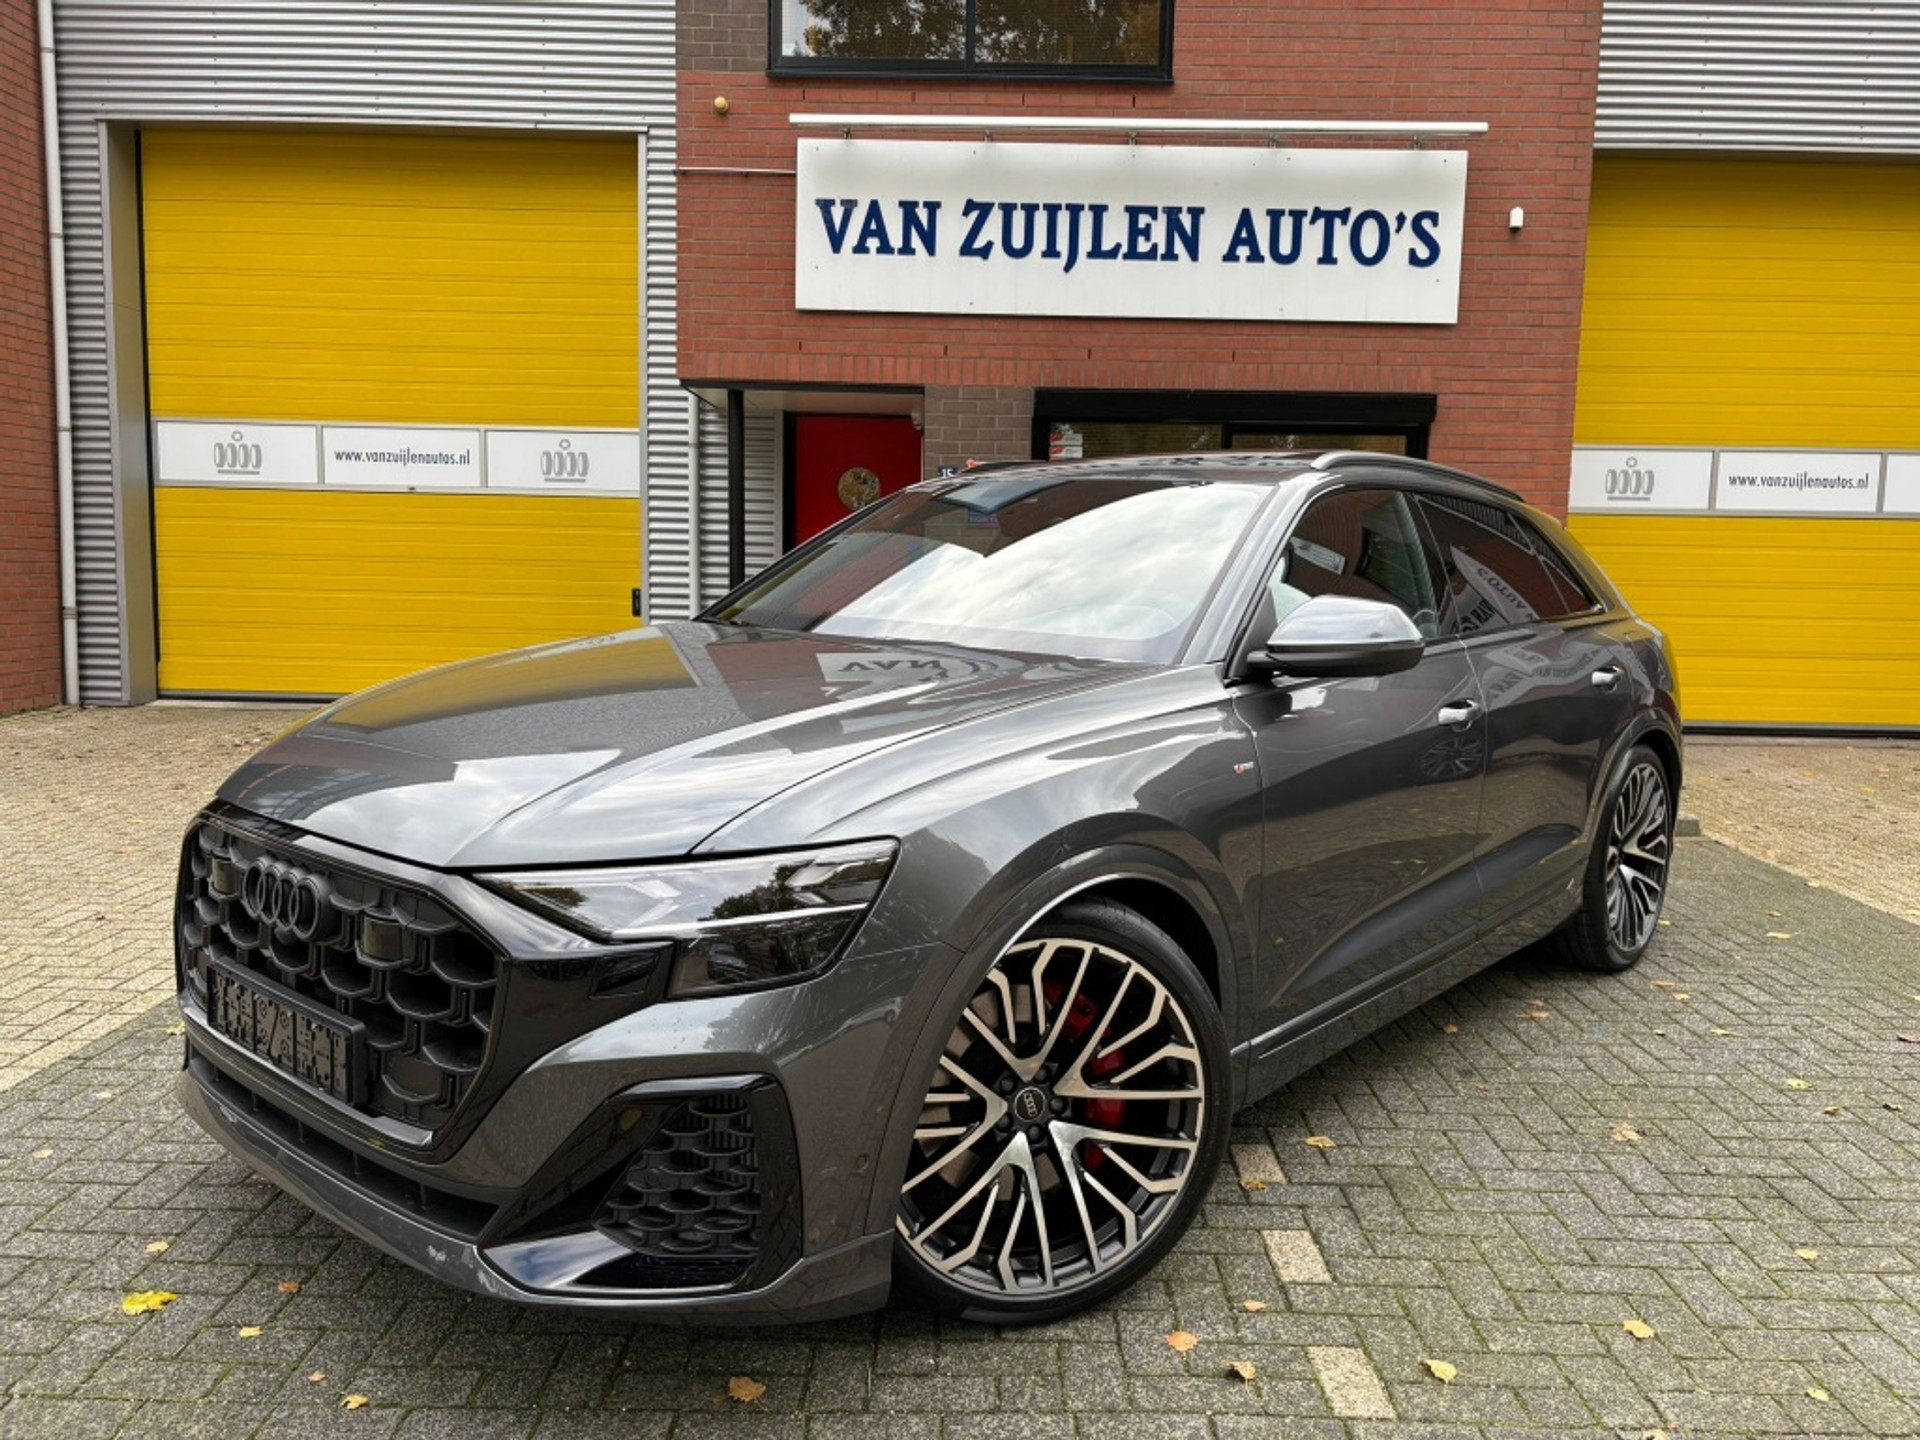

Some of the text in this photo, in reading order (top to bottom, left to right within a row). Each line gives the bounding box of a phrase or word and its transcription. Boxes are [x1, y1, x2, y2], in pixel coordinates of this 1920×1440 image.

[815, 198, 1441, 274] VAN ZUIJLEN AUTO'S
[333, 446, 471, 467] www.vanzuijlenautos.nl
[1728, 471, 1869, 491] www.vanzuijlenautos.nl
